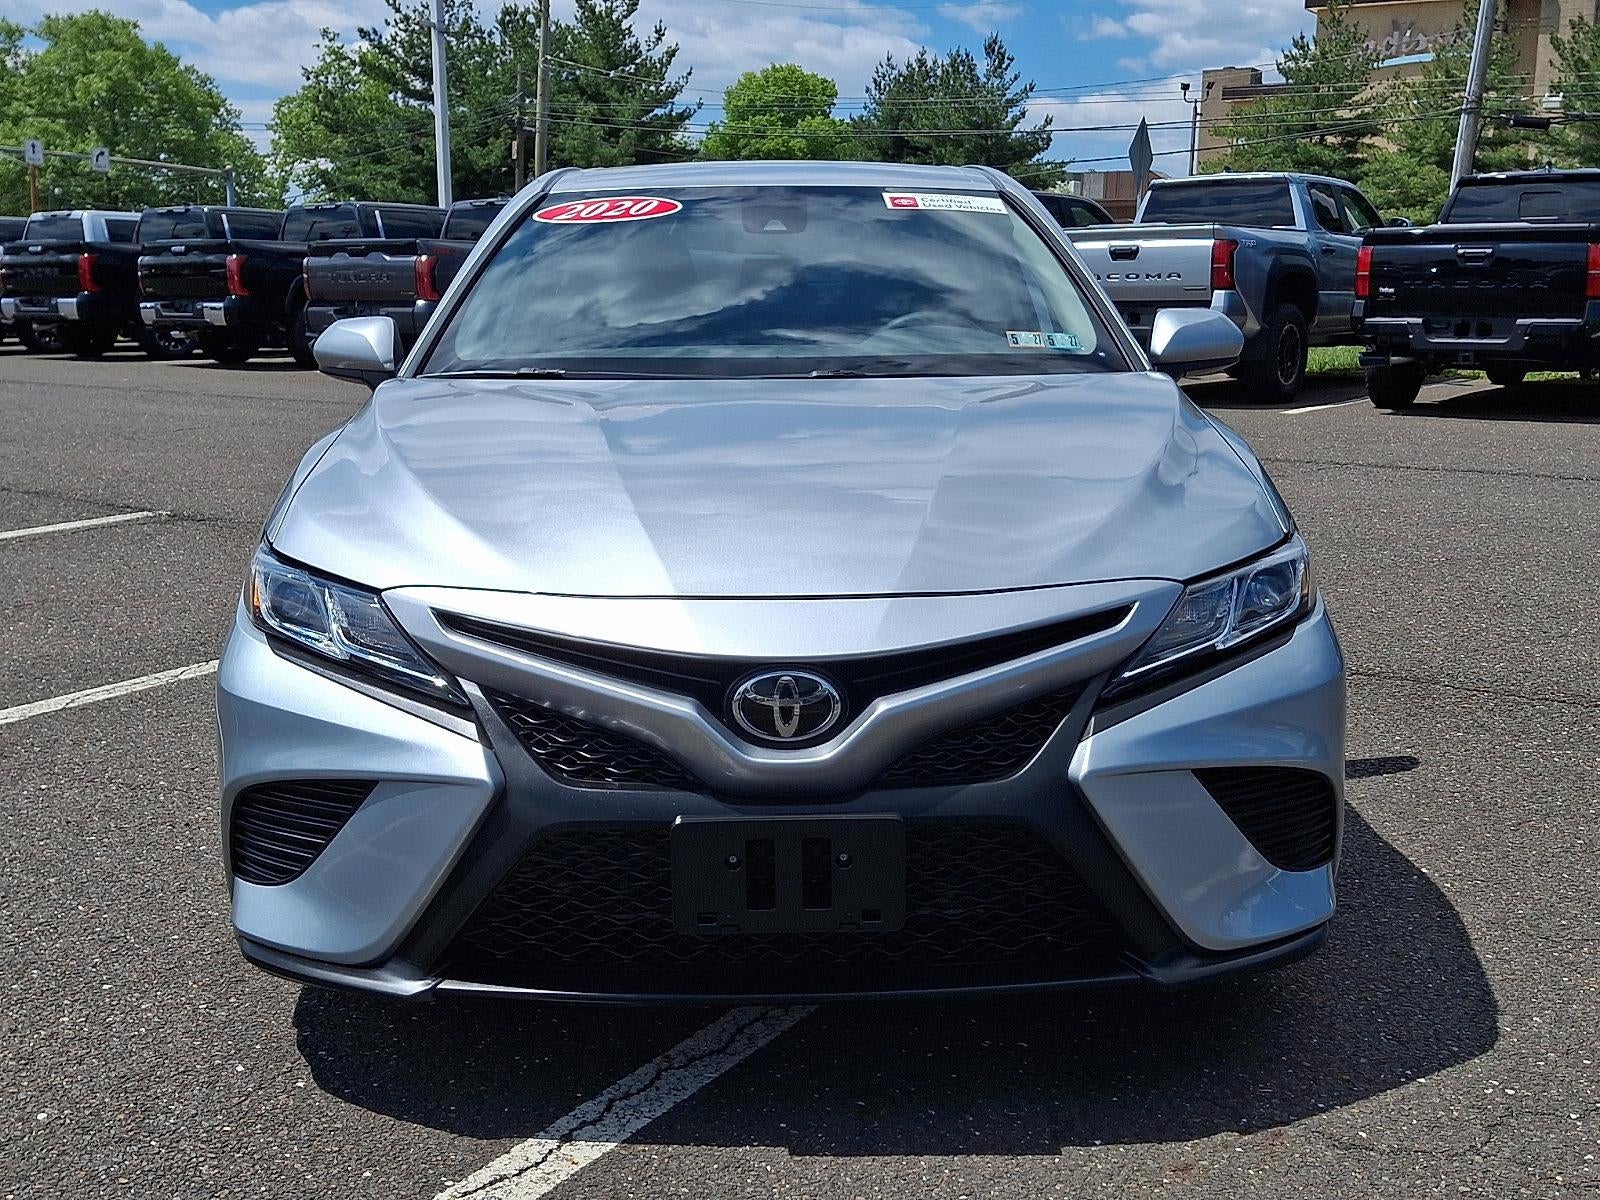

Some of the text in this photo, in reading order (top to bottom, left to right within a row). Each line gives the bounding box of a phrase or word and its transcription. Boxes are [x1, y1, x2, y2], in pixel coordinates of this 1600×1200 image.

[920, 197, 972, 205] Certified
[552, 200, 660, 221] 2020
[955, 203, 1003, 212] Vehicles
[1094, 272, 1183, 283] COMA
